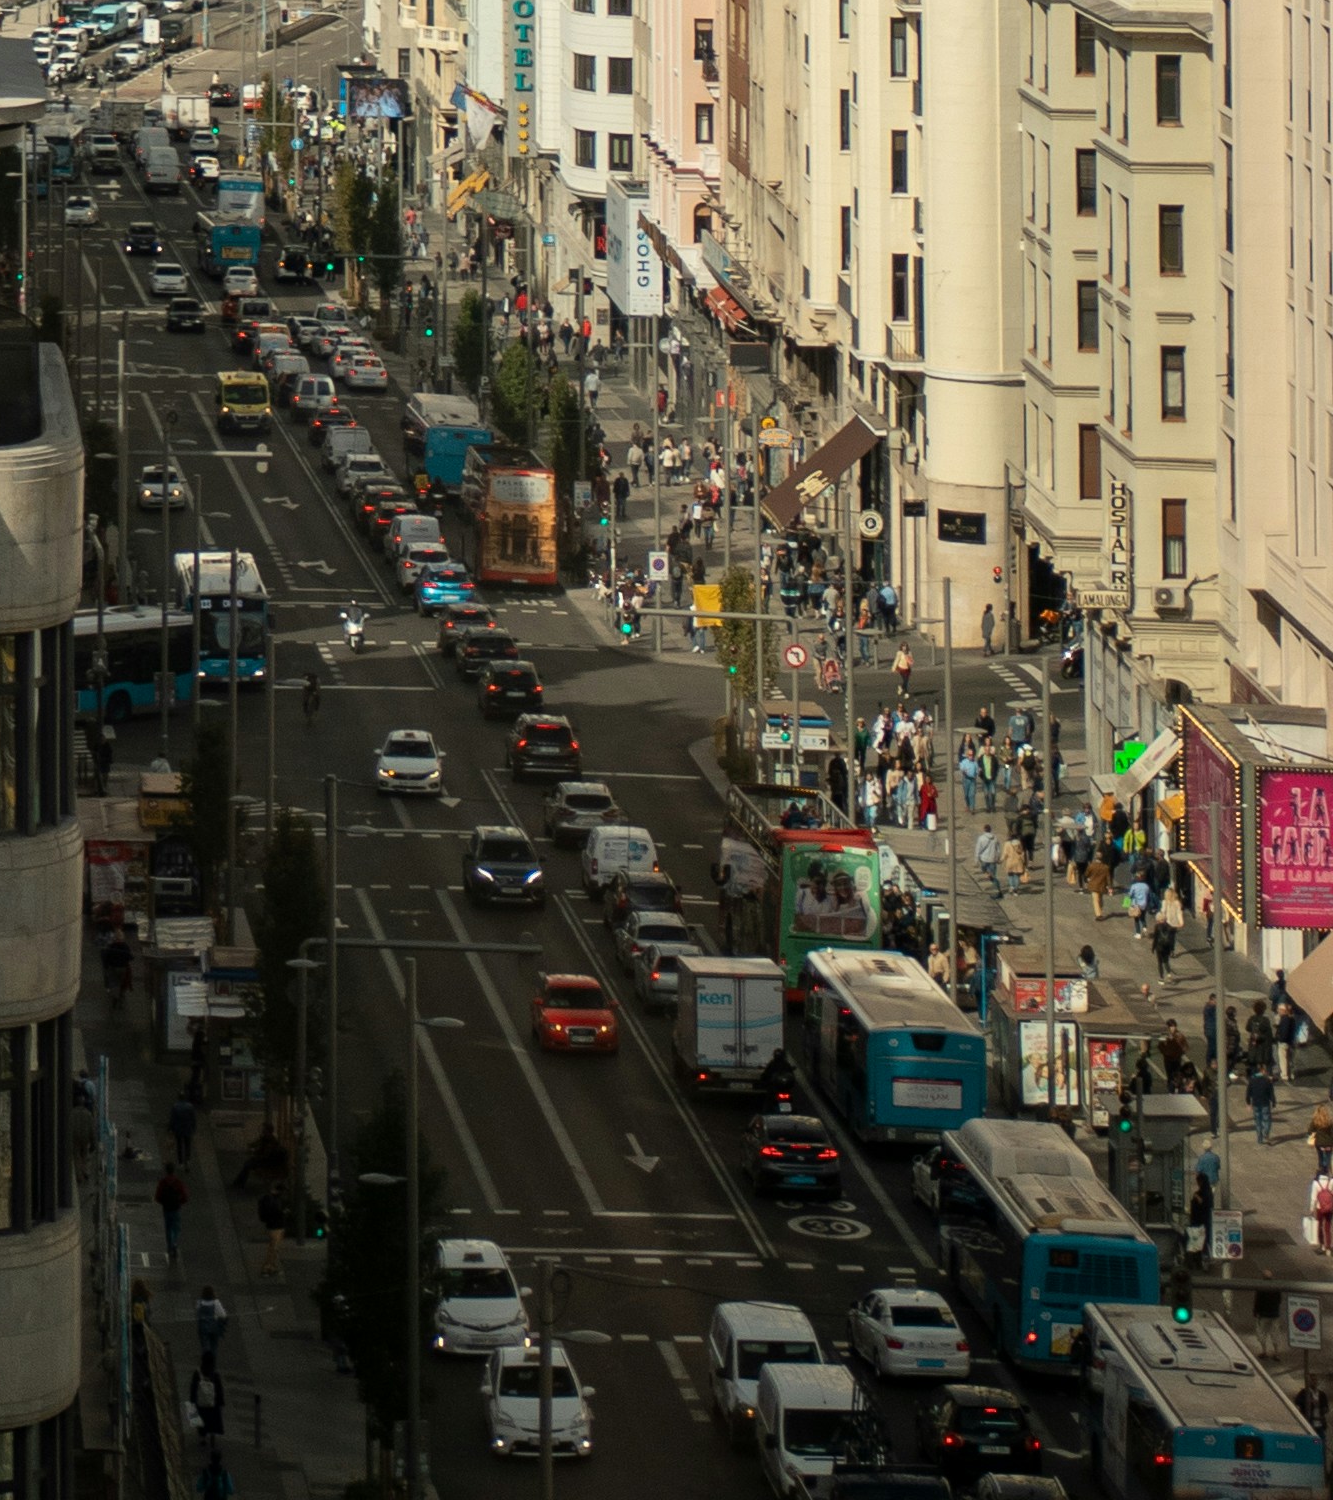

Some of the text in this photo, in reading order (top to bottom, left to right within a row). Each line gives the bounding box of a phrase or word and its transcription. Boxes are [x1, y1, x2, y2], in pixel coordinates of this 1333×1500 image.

[1111, 482, 1127, 565] HOSTAL
[1077, 593, 1128, 608] LAMALONGA
[1290, 786, 1330, 827] LA
